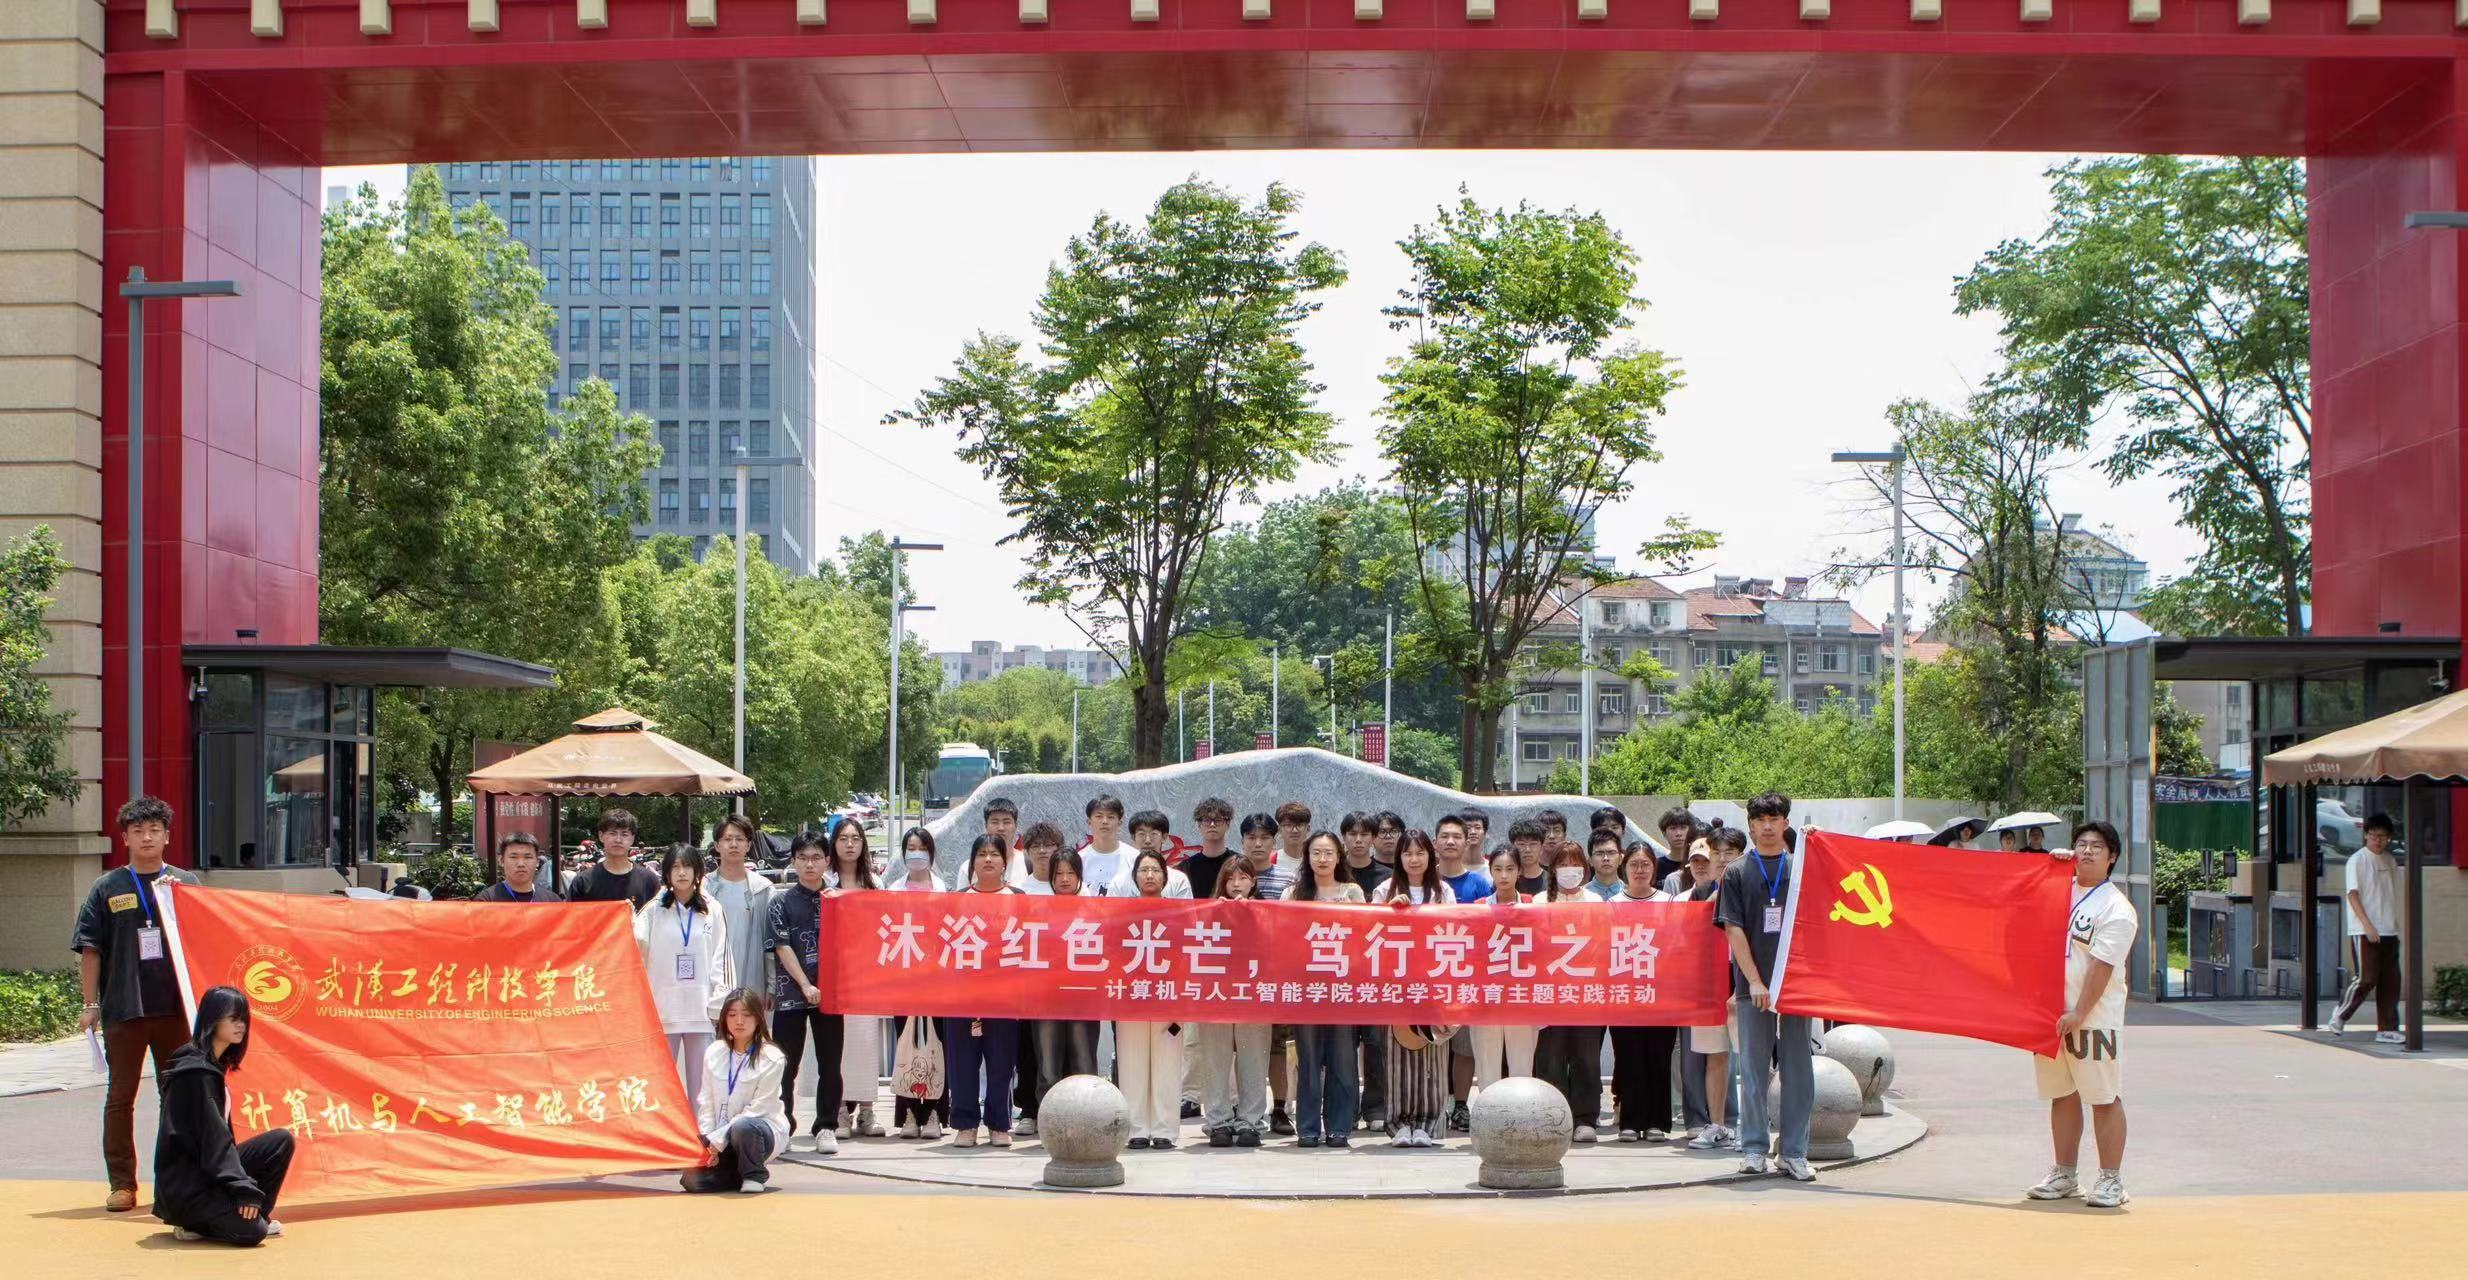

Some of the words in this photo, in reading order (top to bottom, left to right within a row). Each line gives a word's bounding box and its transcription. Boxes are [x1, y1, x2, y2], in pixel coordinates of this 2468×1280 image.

[876, 912, 1660, 979] 沐浴红色光芒，笃行党纪之路
[316, 1006, 364, 1018] WUHAN
[366, 1008, 446, 1020] UNIVERSITY
[447, 1009, 462, 1020] OF
[464, 1007, 553, 1020] ENGINEERING
[553, 1001, 611, 1017] SCIENCE
[240, 1075, 660, 1140] 计算机与人工智能学院
